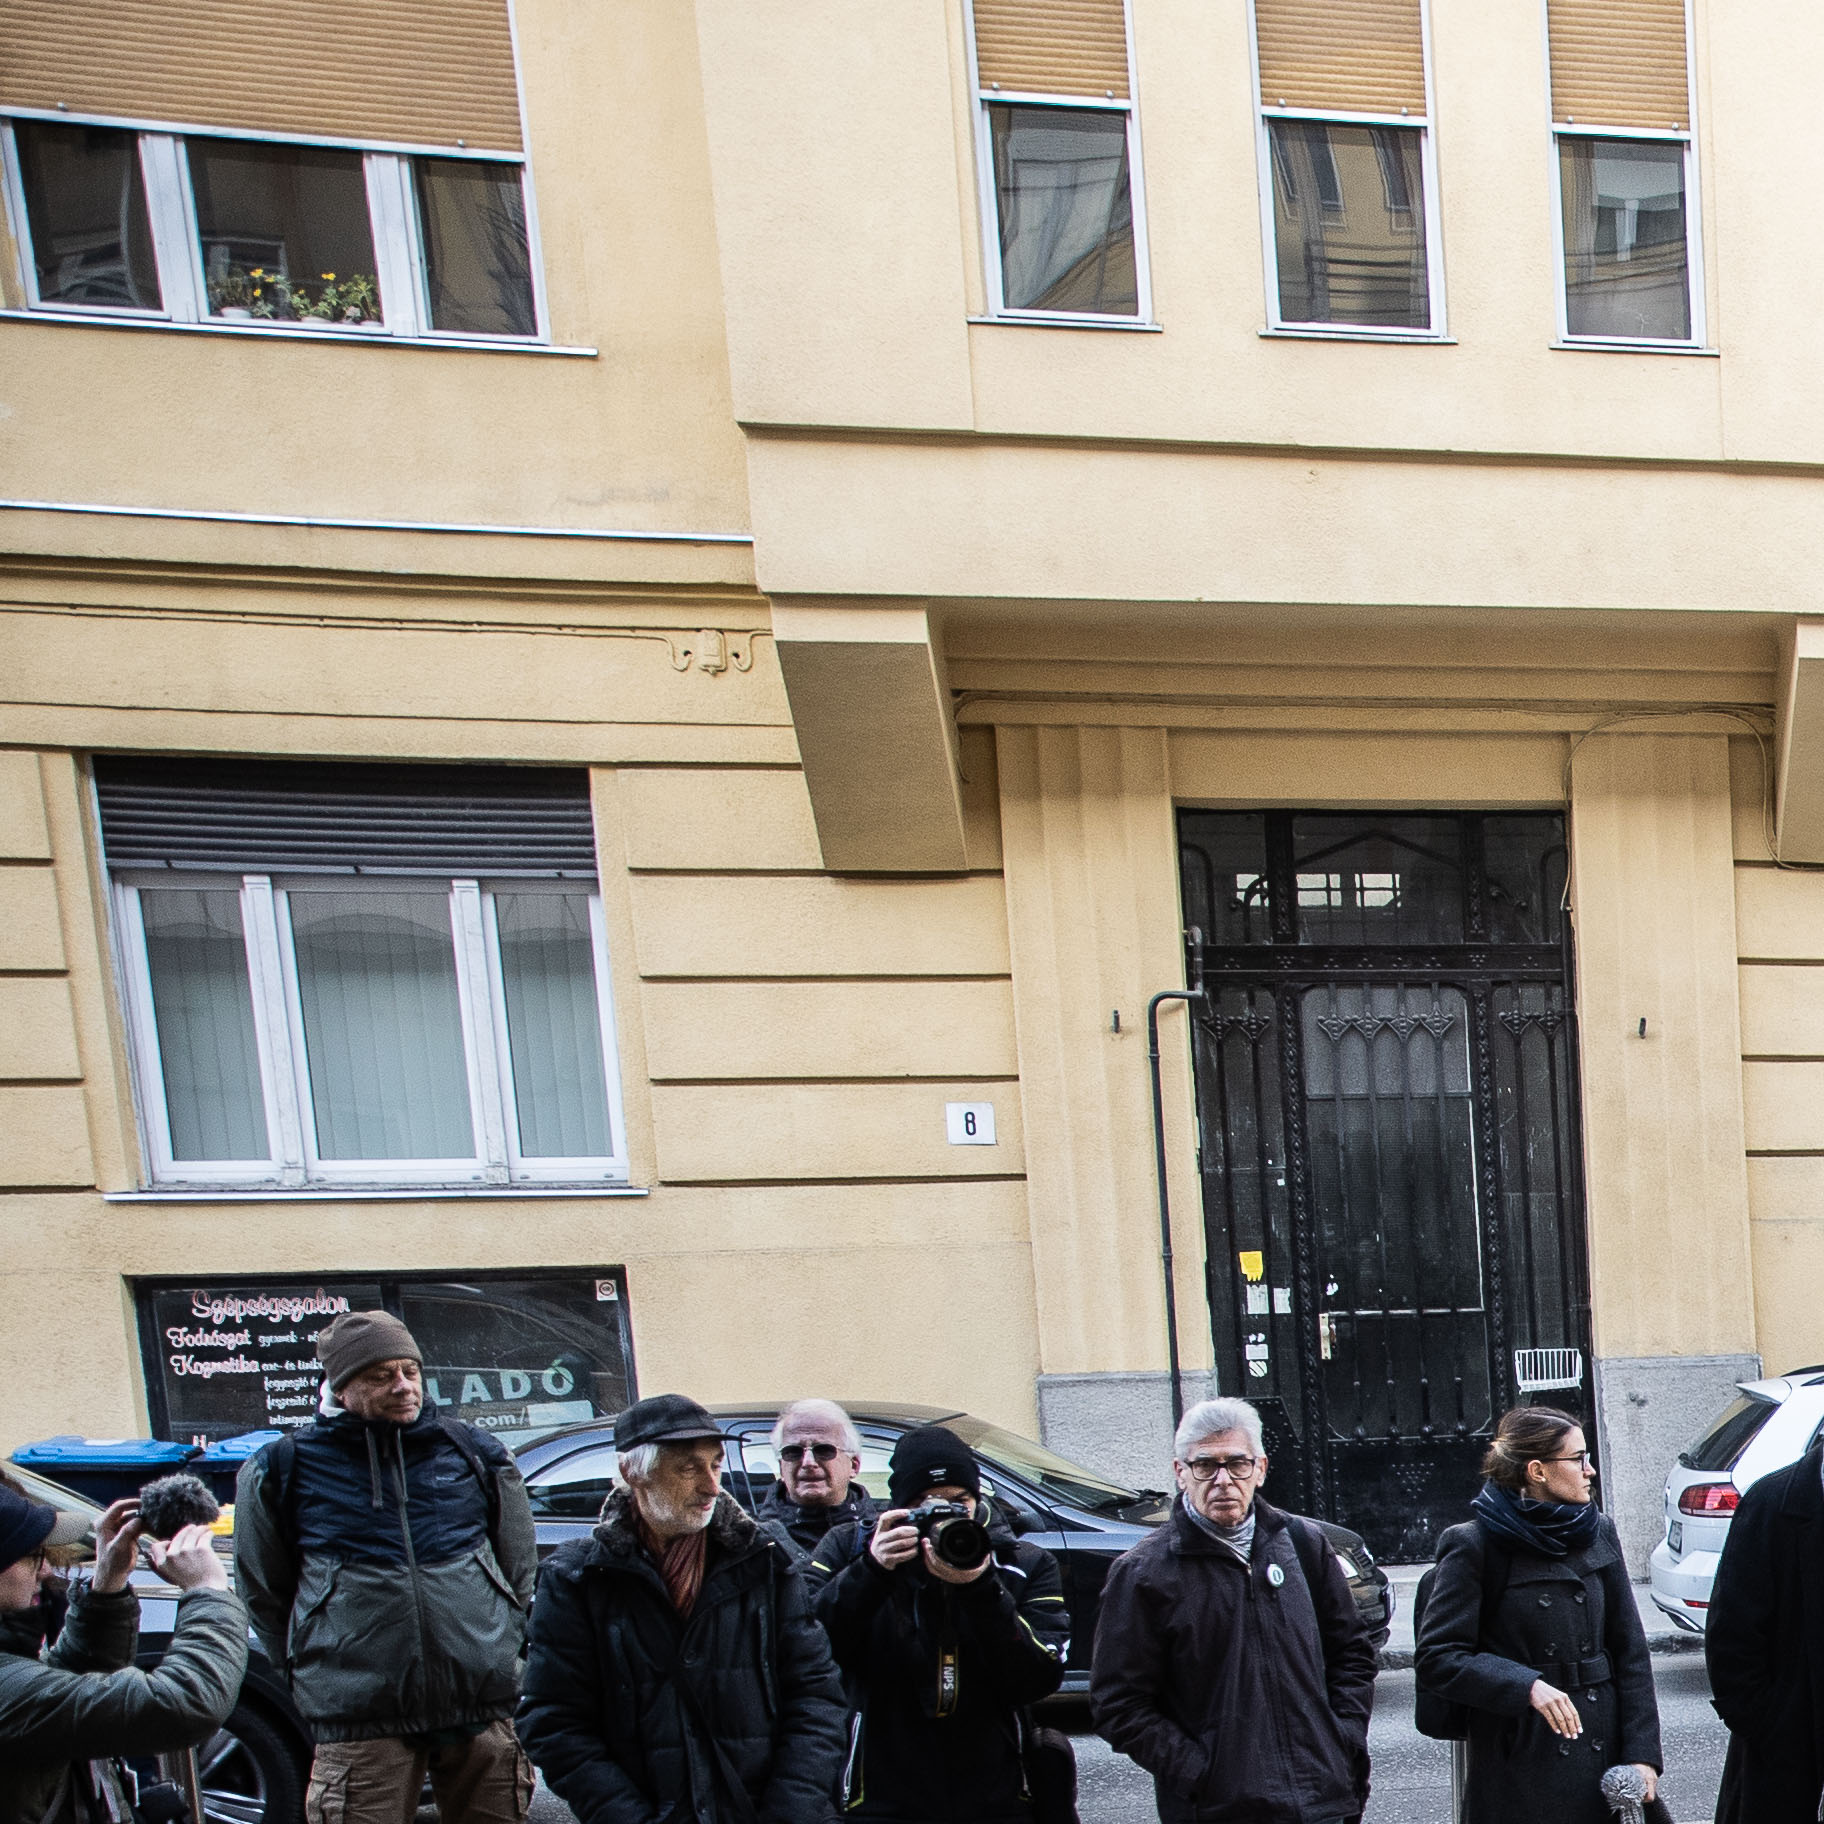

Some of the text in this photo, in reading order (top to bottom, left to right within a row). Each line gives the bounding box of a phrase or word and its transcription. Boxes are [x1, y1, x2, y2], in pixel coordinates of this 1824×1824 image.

[965, 1111, 977, 1136] 8
[192, 1288, 350, 1325] Szépségszalon
[167, 1326, 252, 1351] Fodrászat
[170, 1354, 261, 1379] Kozmetika
[426, 1359, 575, 1407] LADÓ
